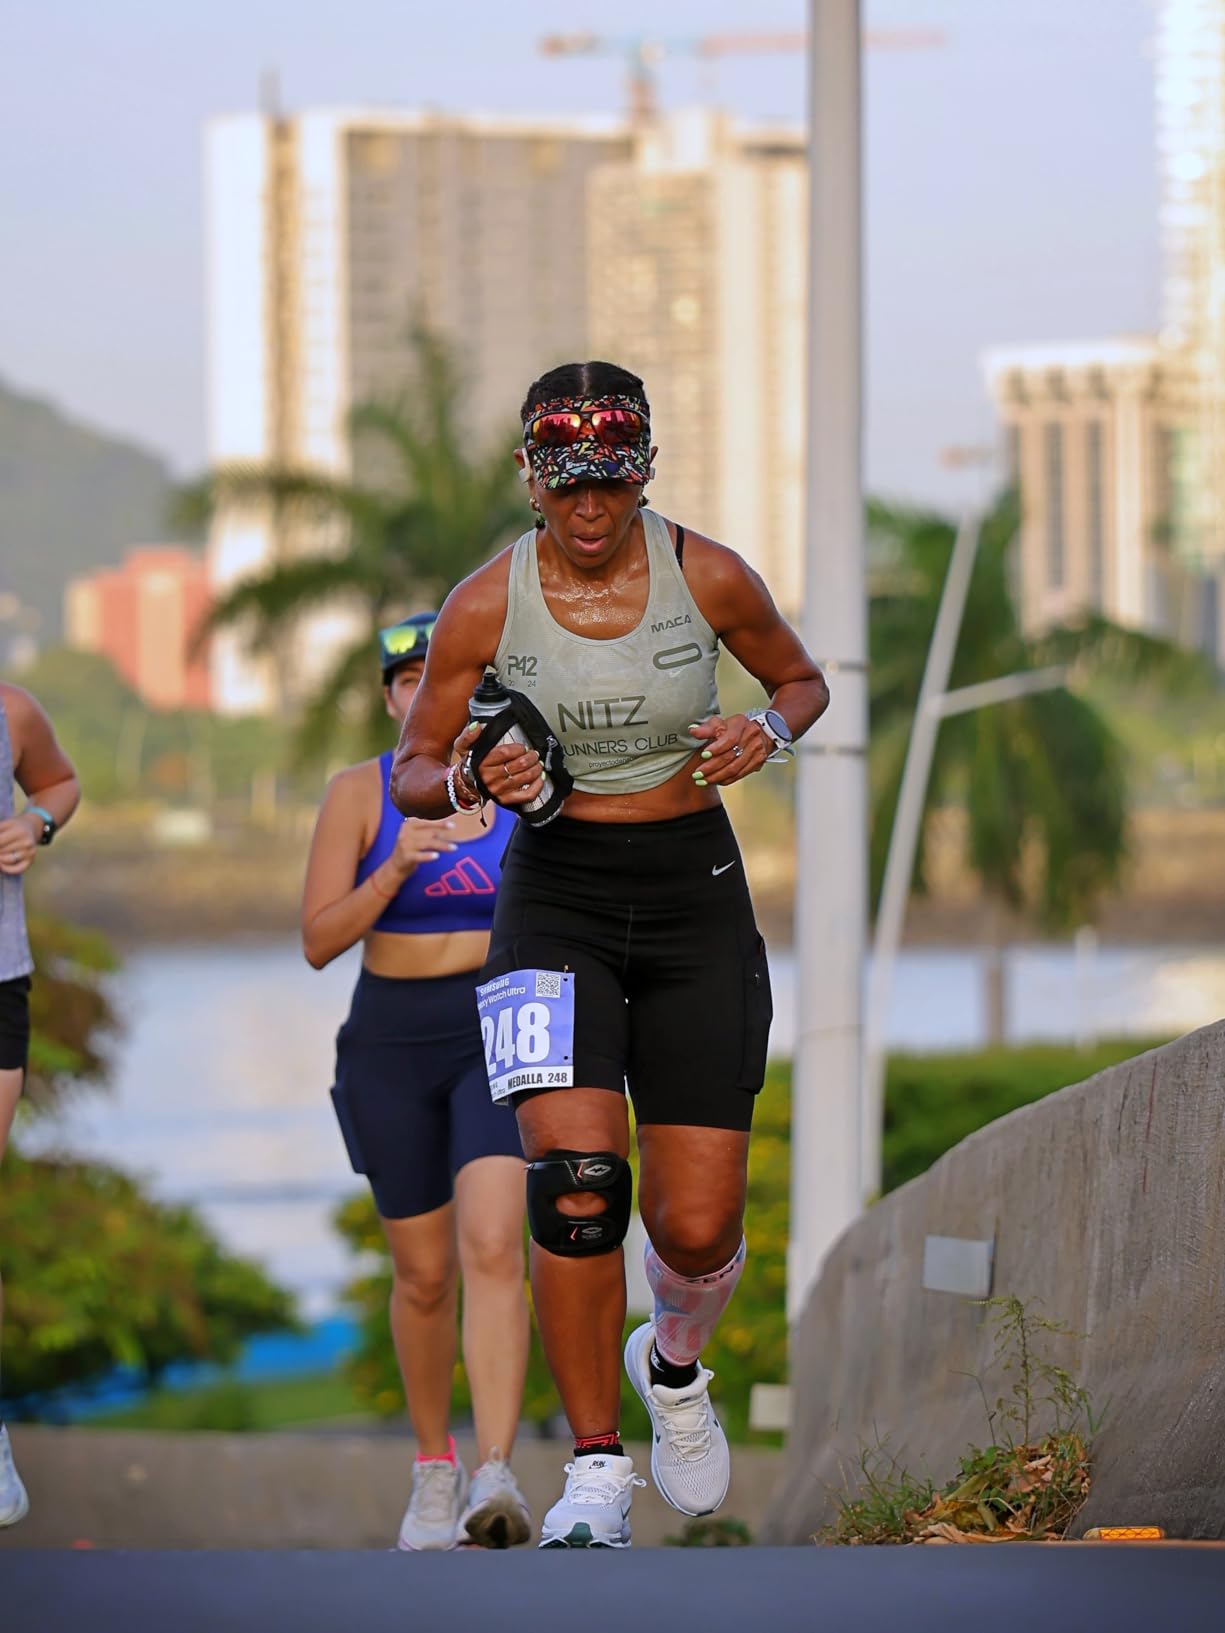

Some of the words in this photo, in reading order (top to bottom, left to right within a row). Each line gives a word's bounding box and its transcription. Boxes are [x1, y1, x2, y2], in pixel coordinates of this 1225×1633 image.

[651, 614, 692, 633] MACA
[508, 655, 538, 677] P42
[527, 679, 537, 688] 24
[557, 695, 649, 733] NITZ
[562, 739, 628, 757] UNNERS
[634, 733, 679, 751] CLUB
[480, 977, 510, 997] SAMSUNG
[487, 990, 507, 1005] Watch
[507, 986, 526, 997] Ultra
[480, 1002, 551, 1078] 248
[507, 1072, 543, 1090] MEDALLA
[547, 1072, 568, 1084] 248
